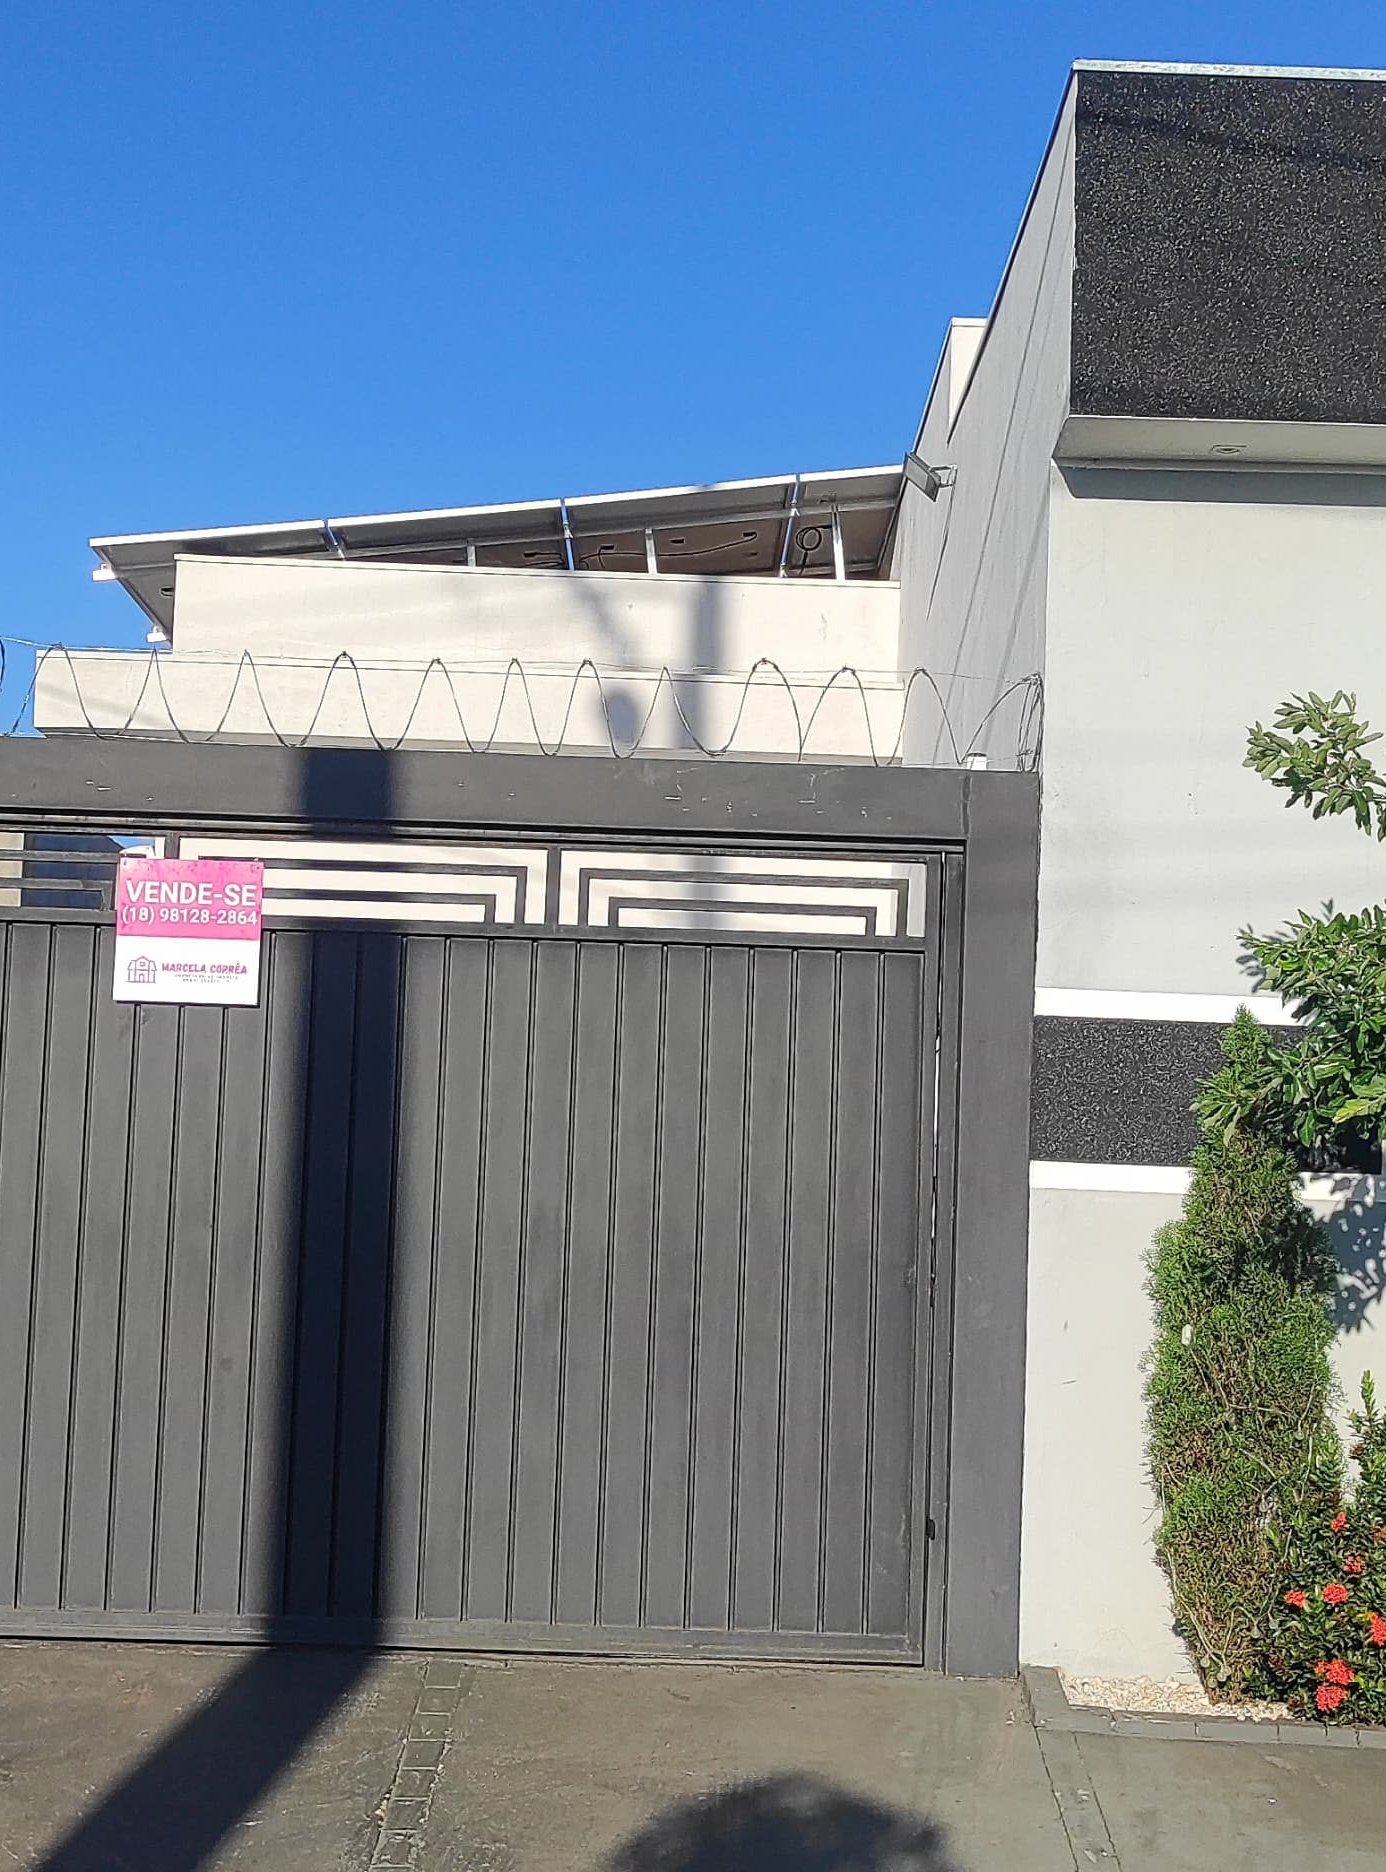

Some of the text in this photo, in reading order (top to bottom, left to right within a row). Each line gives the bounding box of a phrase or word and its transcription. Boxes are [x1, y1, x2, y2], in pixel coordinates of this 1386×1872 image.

[125, 880, 258, 906] VENDE-SE
[121, 905, 258, 926] (18) 98128-2864
[161, 962, 207, 973] MARCELA
